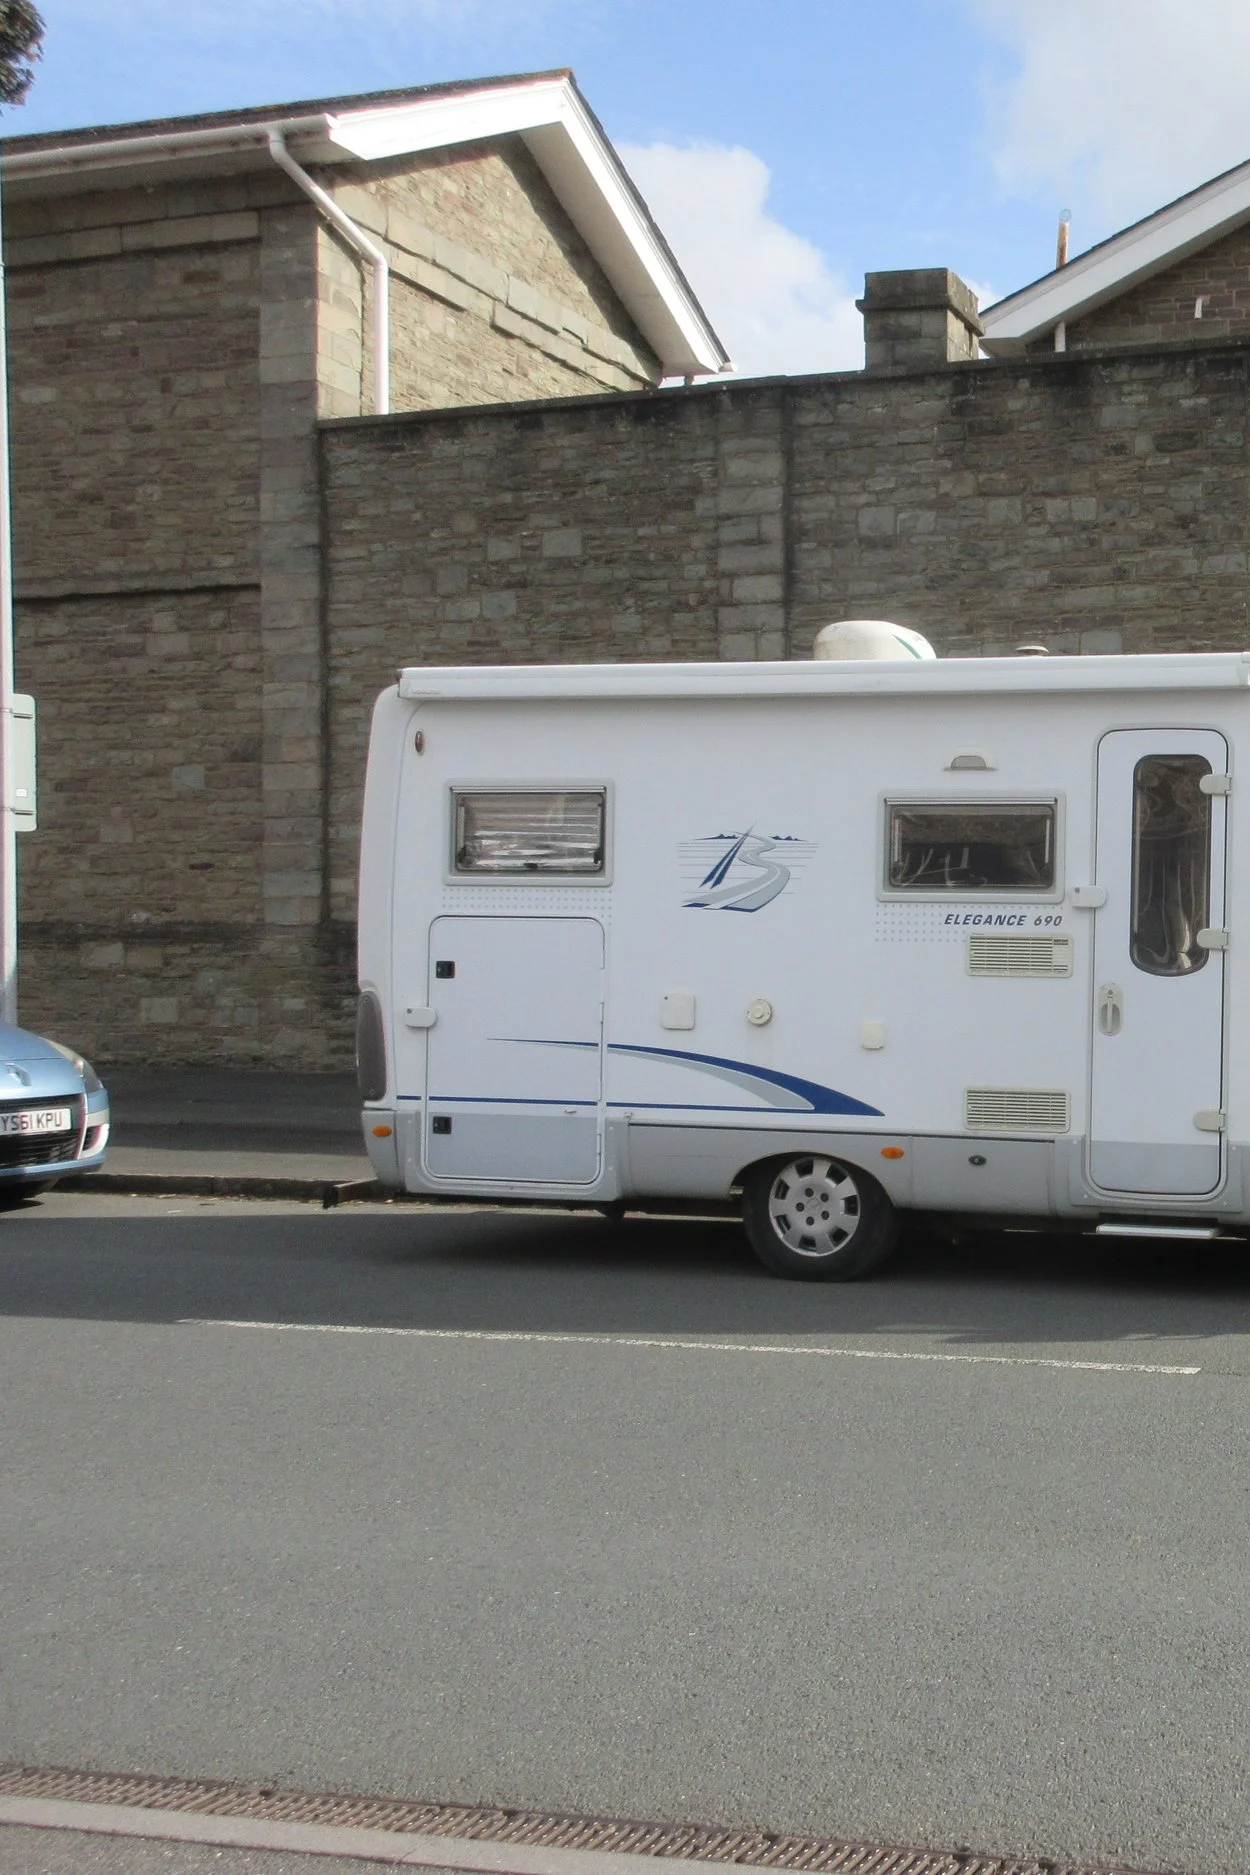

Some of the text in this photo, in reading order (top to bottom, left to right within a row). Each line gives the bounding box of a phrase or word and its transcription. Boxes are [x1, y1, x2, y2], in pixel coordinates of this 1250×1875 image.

[944, 914, 1063, 926] ELEGANCE 690
[1, 1111, 63, 1131] YS61 KPU
